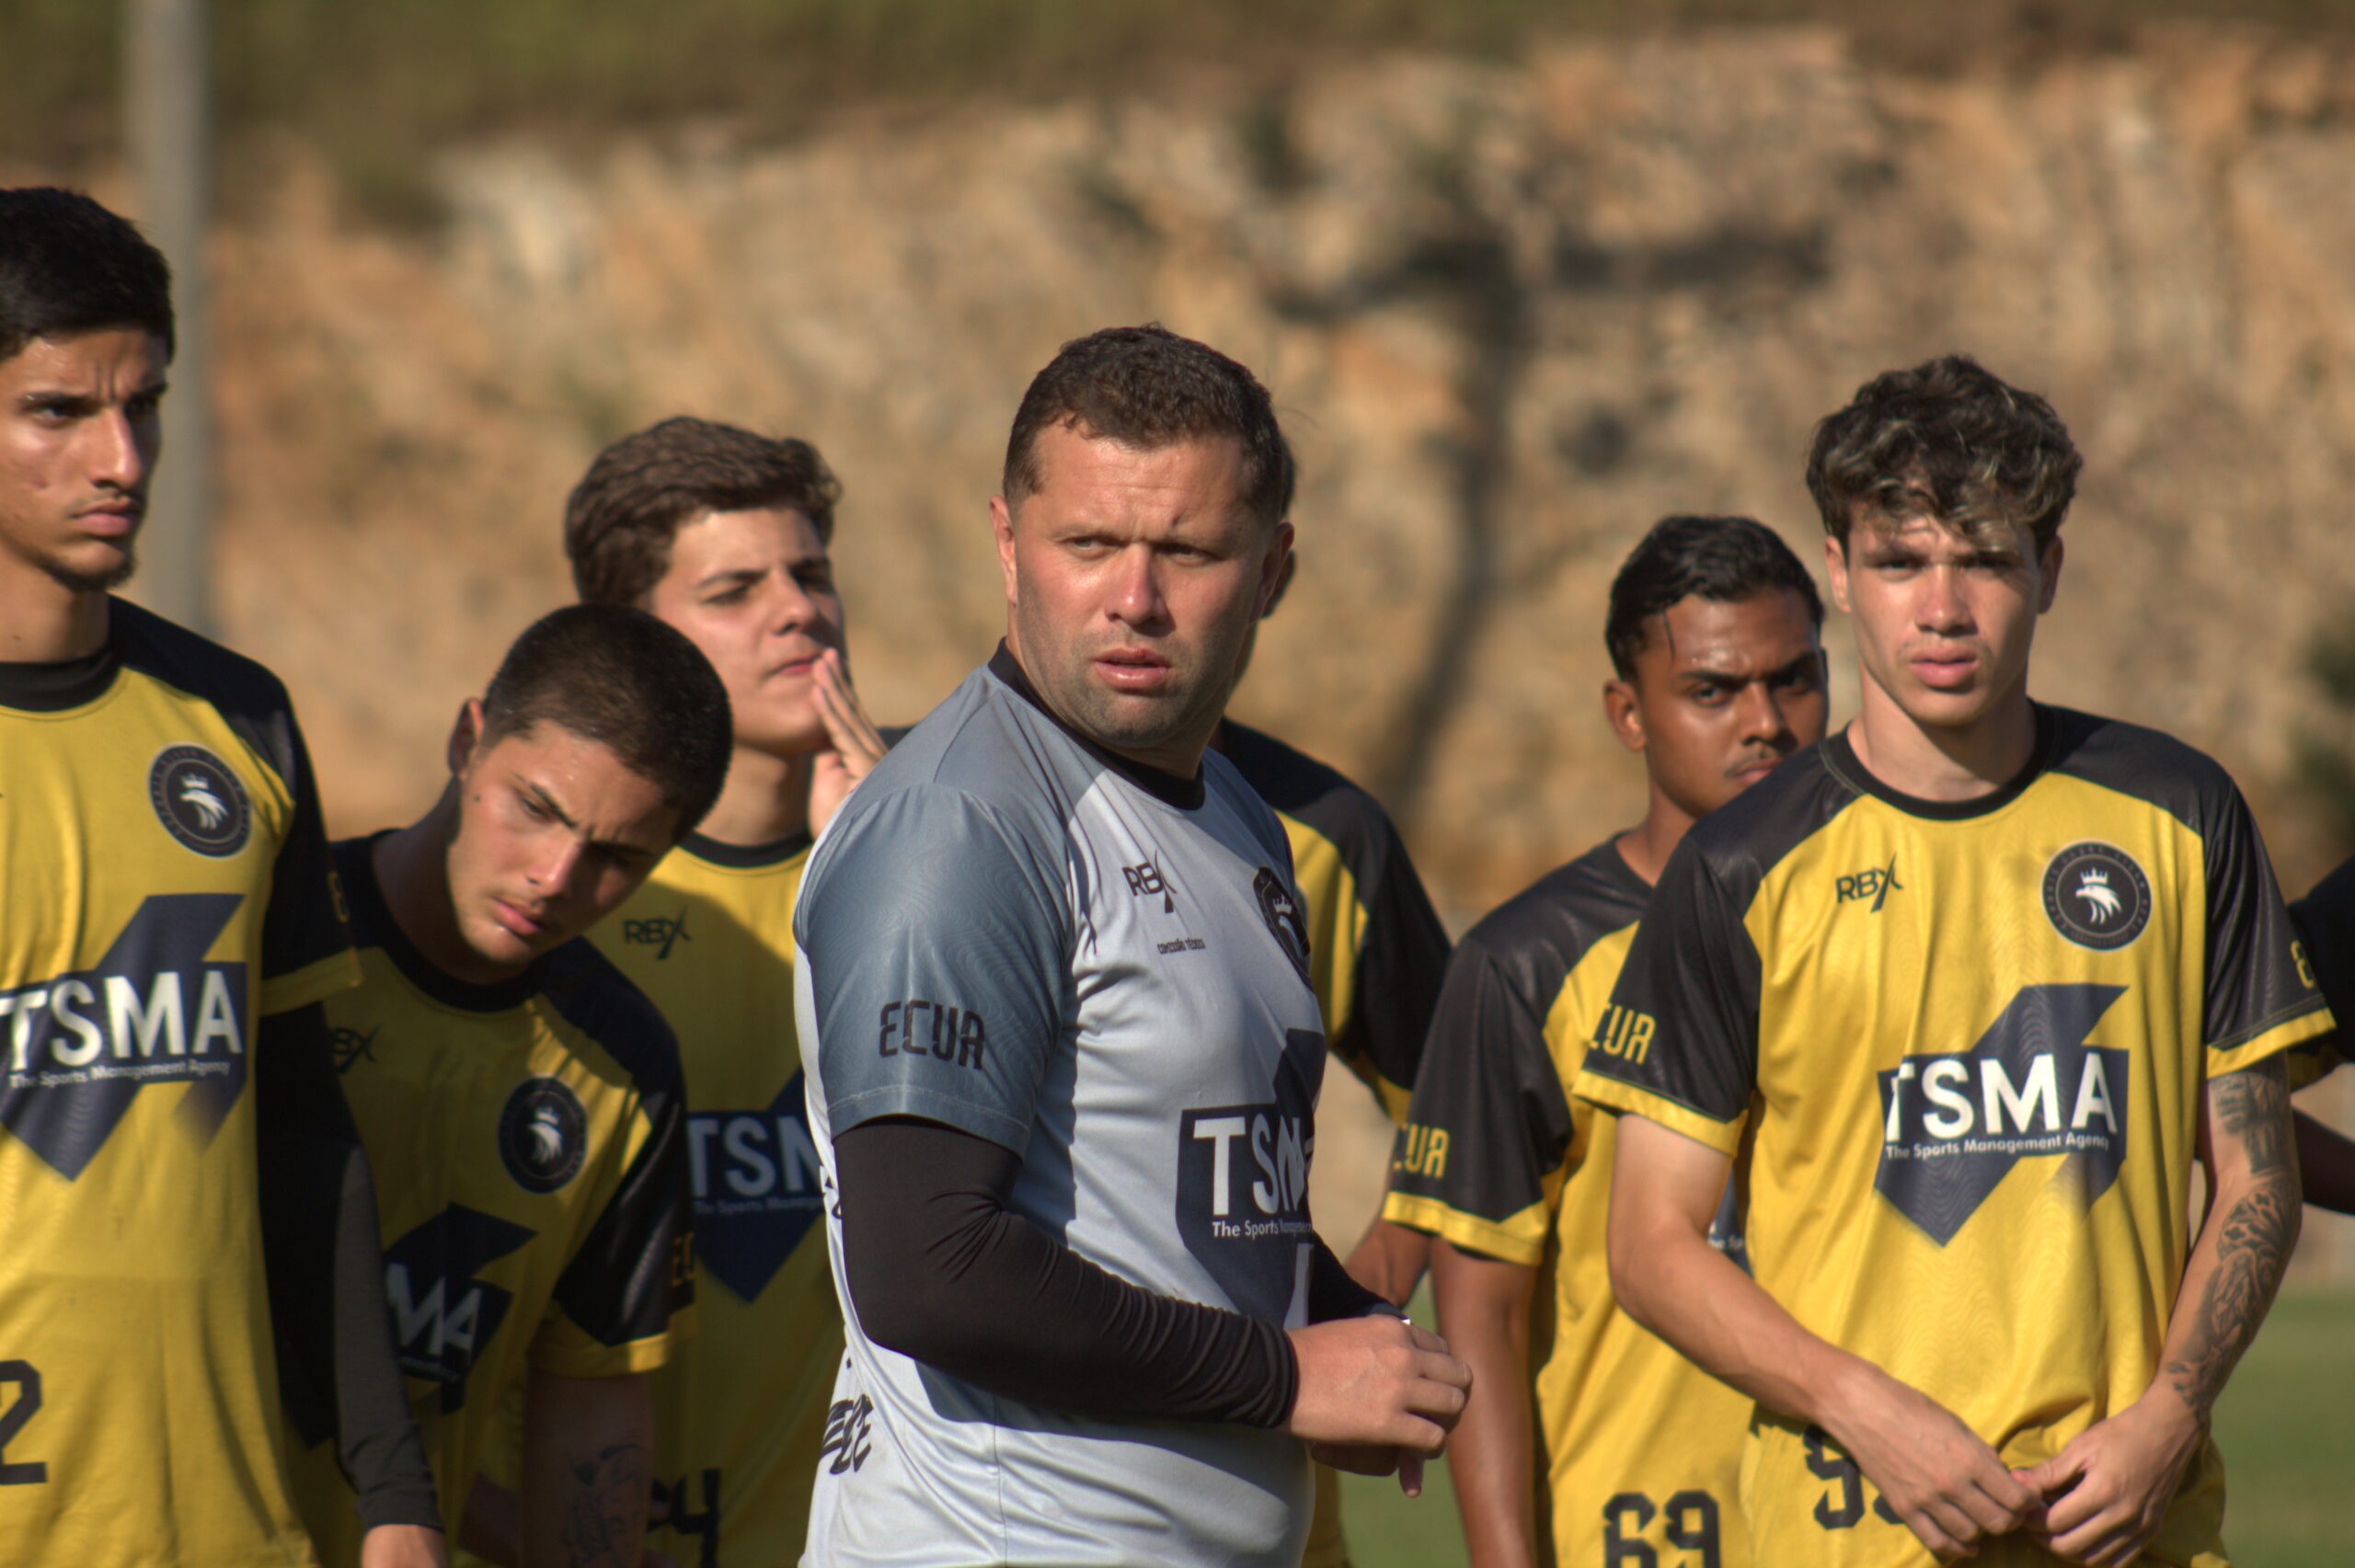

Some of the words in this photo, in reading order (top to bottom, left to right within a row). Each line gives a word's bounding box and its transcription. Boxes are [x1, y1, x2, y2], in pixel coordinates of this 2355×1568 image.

[1836, 852, 1903, 913] RBX
[625, 907, 693, 960] RBX
[0, 970, 242, 1071] TSMA
[1886, 1052, 2117, 1142] TSMA
[688, 1115, 821, 1197] TSM
[1193, 1114, 1315, 1214] TSM
[1886, 1146, 1910, 1160] The
[1913, 1142, 1960, 1161] Sports
[1964, 1136, 2062, 1154] Management
[1212, 1220, 1242, 1238] The
[1245, 1219, 1280, 1241] Sports
[387, 1263, 482, 1367] MA
[648, 1468, 721, 1568] 4
[1802, 1424, 1906, 1530] 9
[1603, 1490, 1721, 1568] 69
